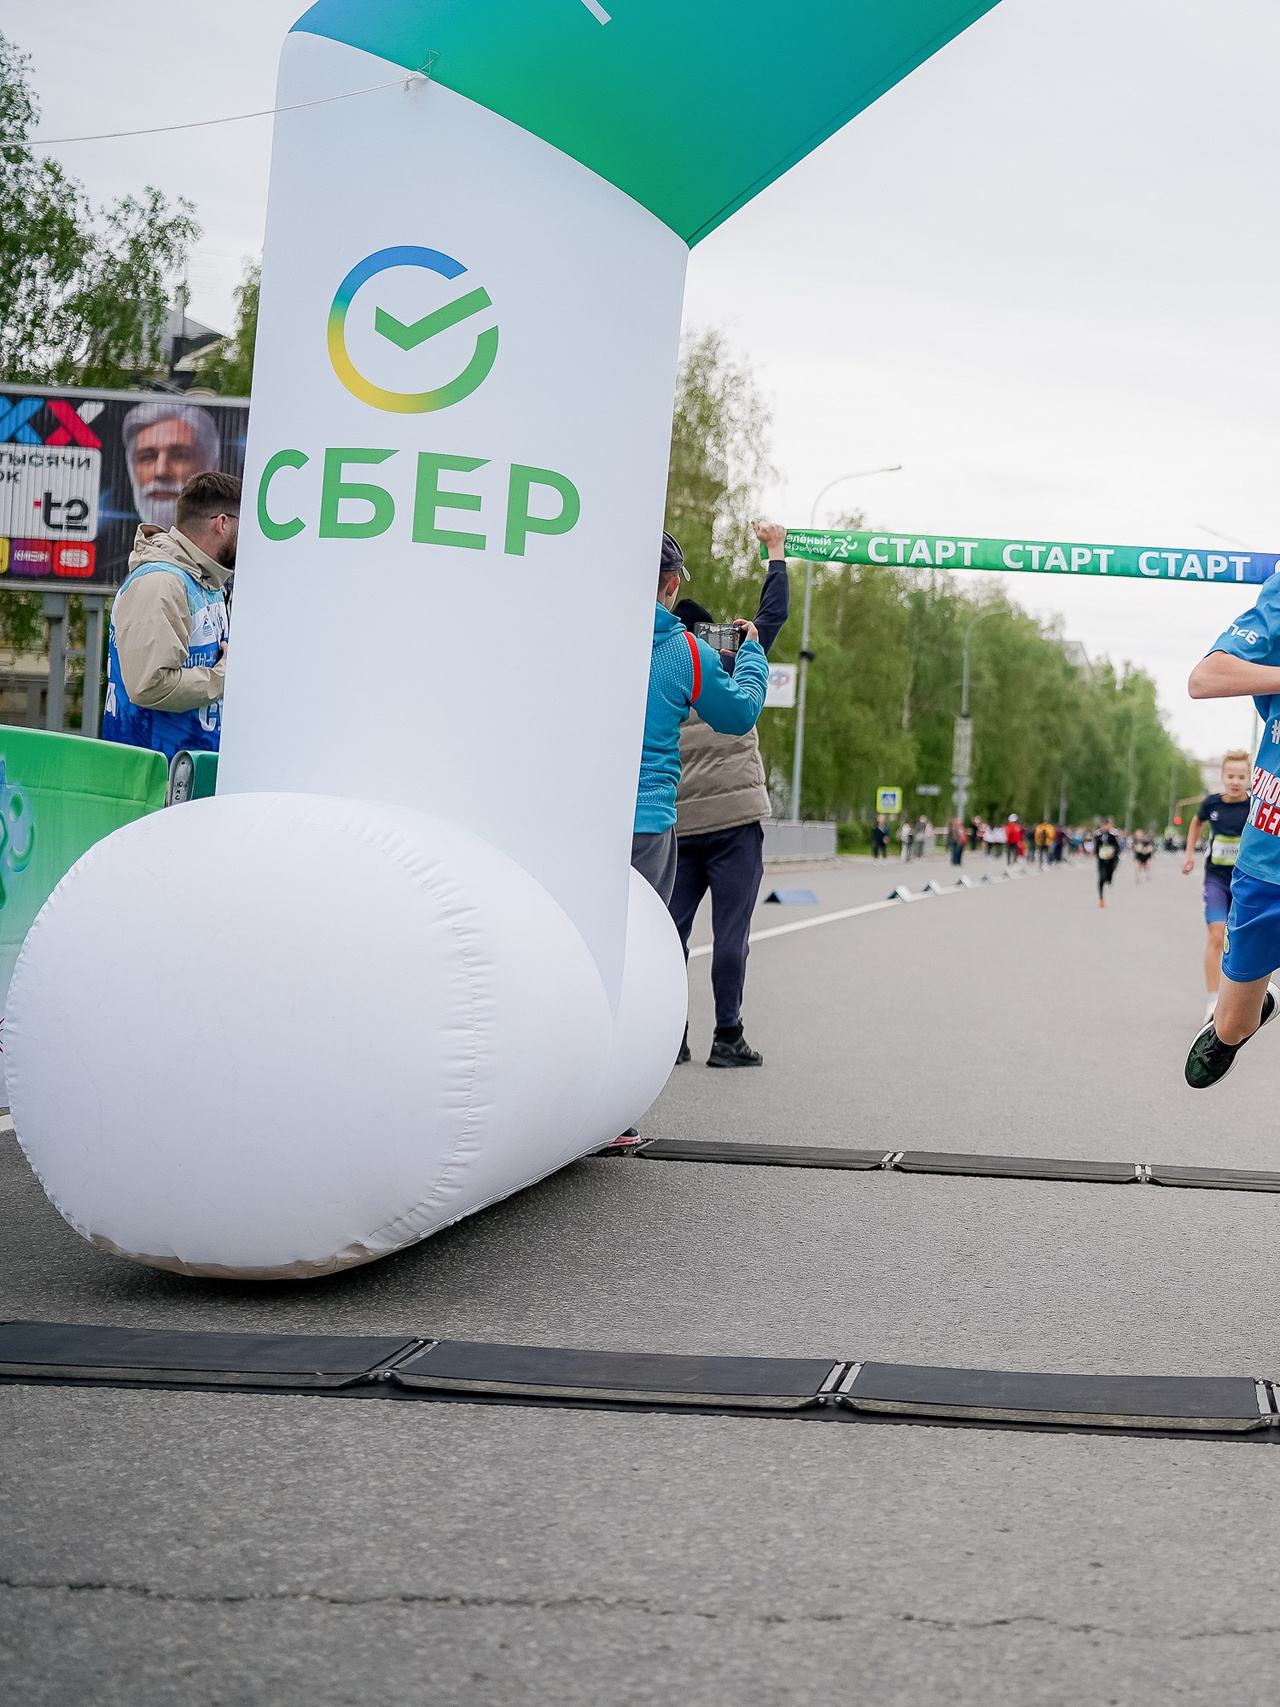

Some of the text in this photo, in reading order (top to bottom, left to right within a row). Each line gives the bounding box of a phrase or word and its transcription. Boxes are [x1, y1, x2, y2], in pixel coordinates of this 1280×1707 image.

[257, 447, 581, 557] СБЕР
[867, 537, 979, 566] СТАРТ
[1002, 544, 1115, 573] СТАРТ
[1138, 551, 1251, 581] СТАРТ
